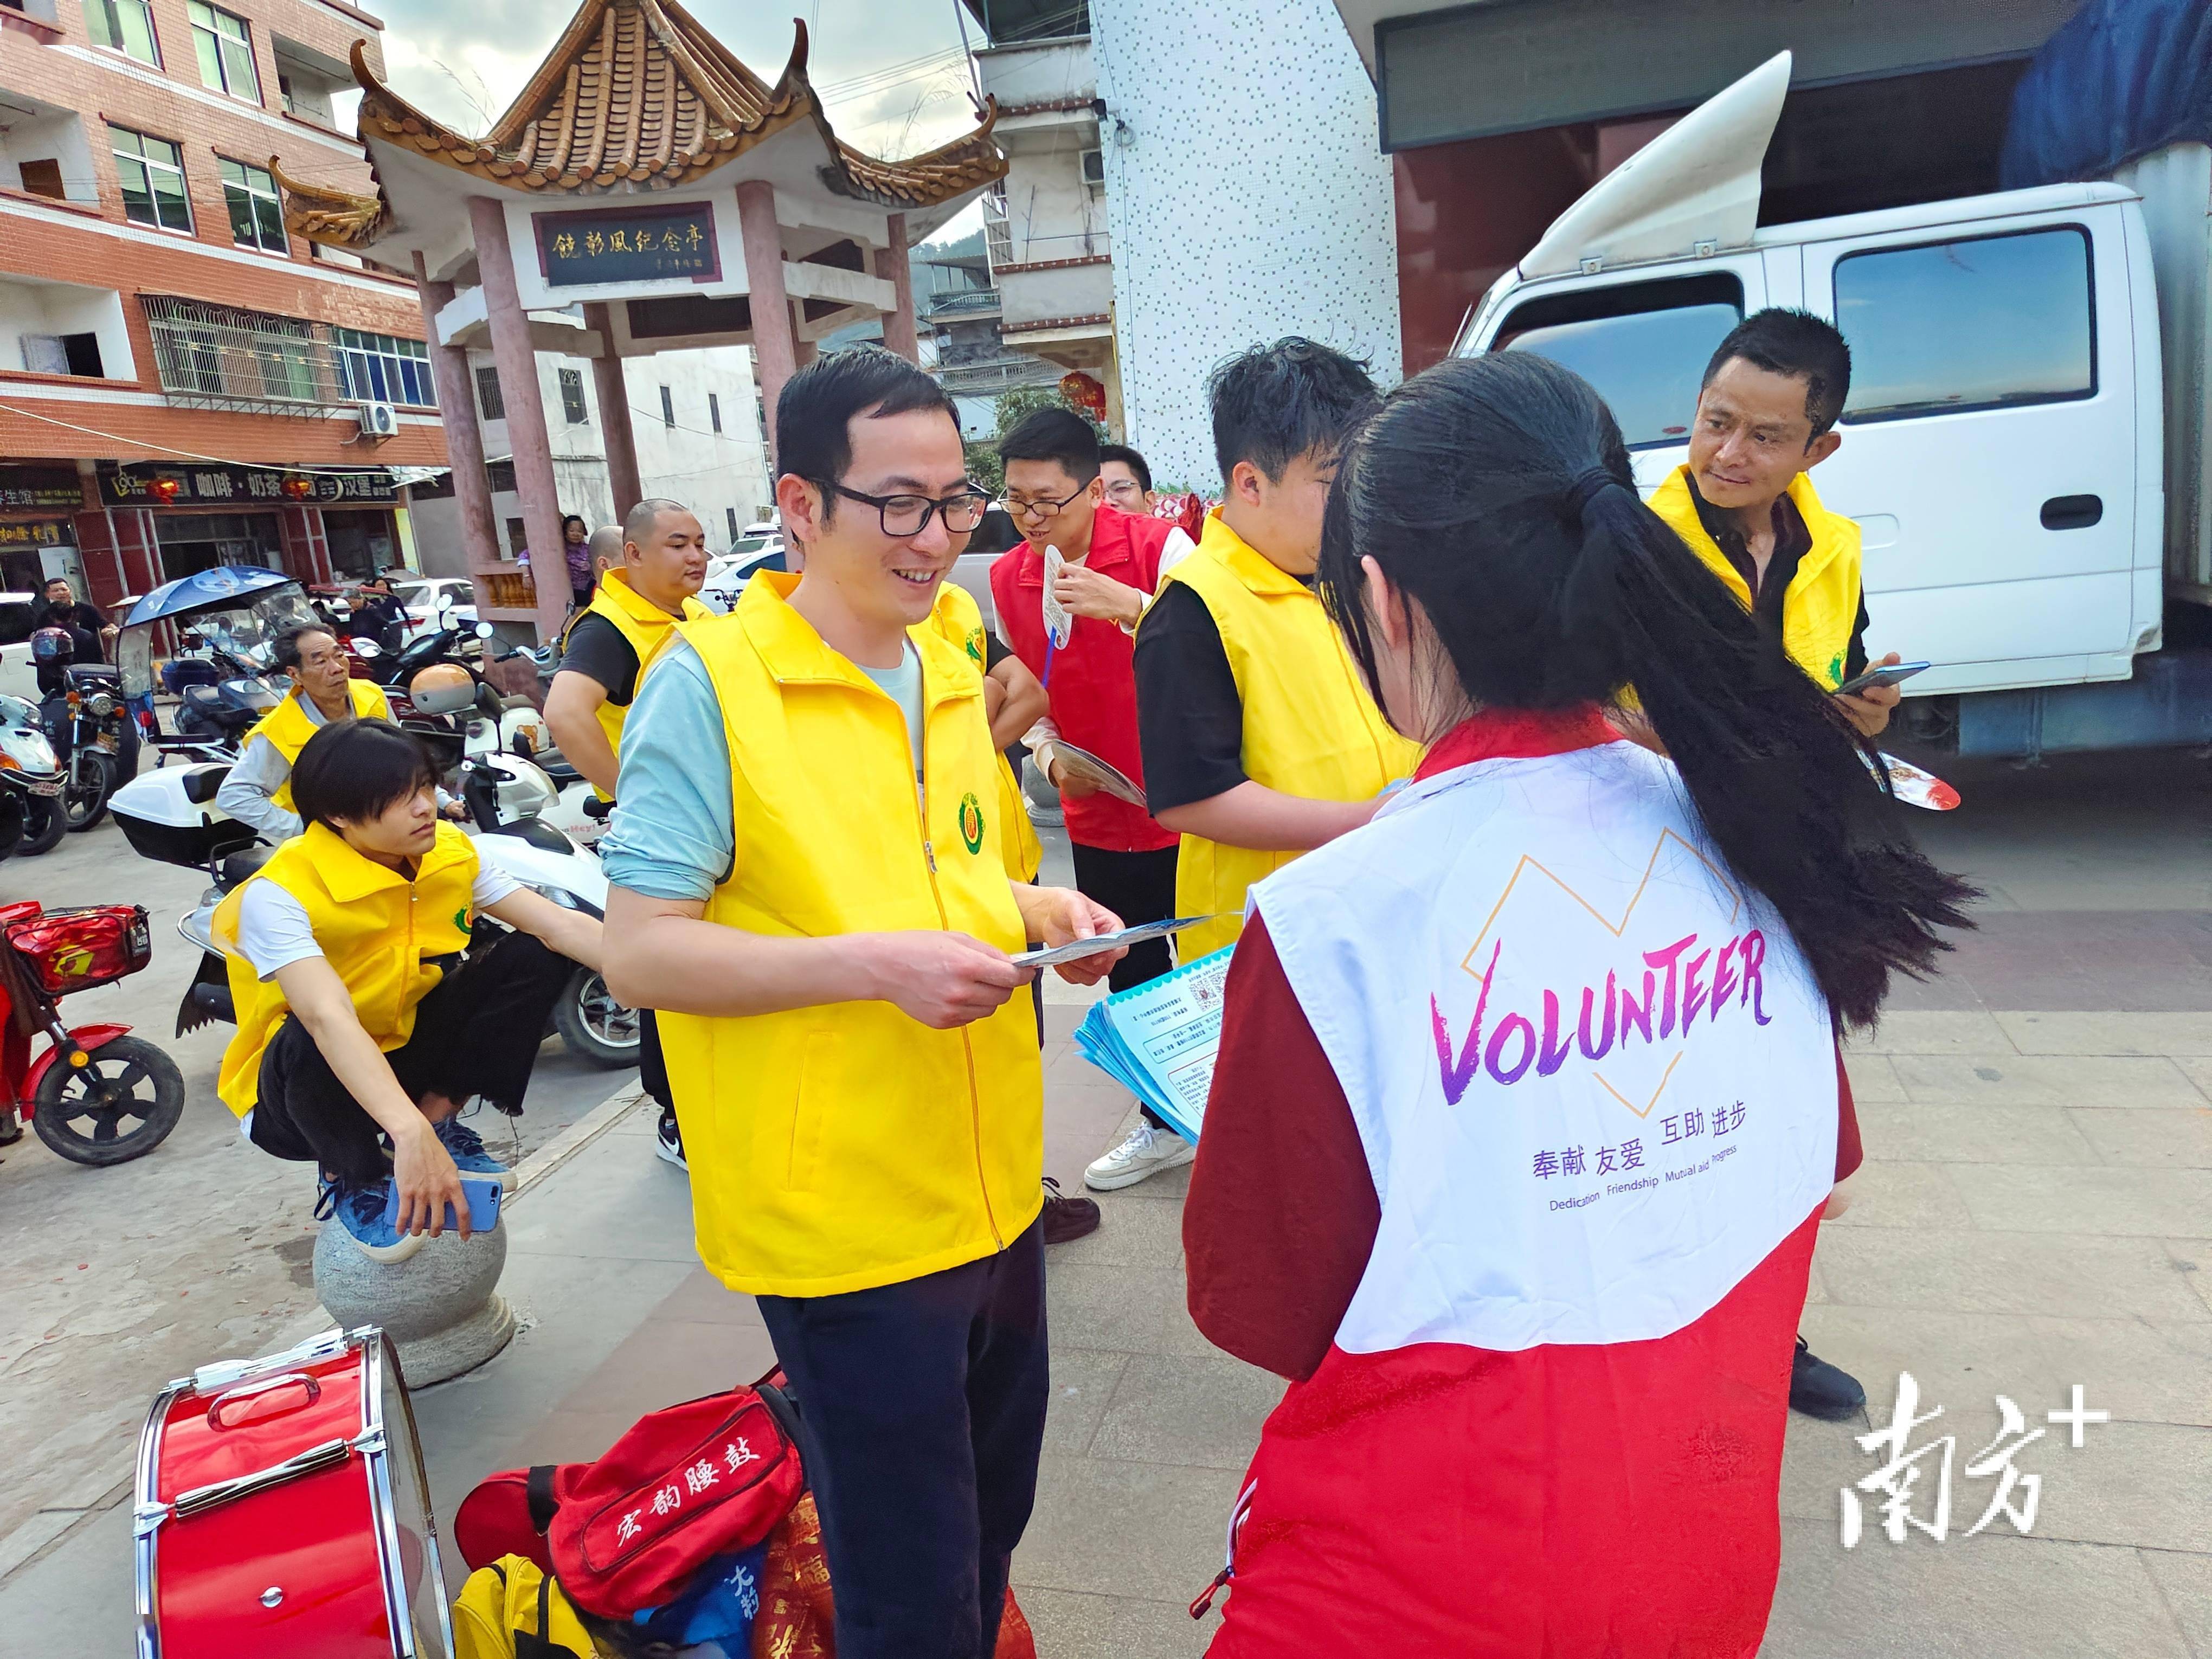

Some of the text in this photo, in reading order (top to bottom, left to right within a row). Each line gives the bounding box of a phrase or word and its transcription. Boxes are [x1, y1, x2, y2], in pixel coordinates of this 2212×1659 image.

[1533, 1100, 1746, 1180] 奉献 友爱 互助 进步
[1549, 1145, 1737, 1211] Dedication Friendship Mutual aid Progress
[617, 1437, 760, 1548] 宏韵腰鼓
